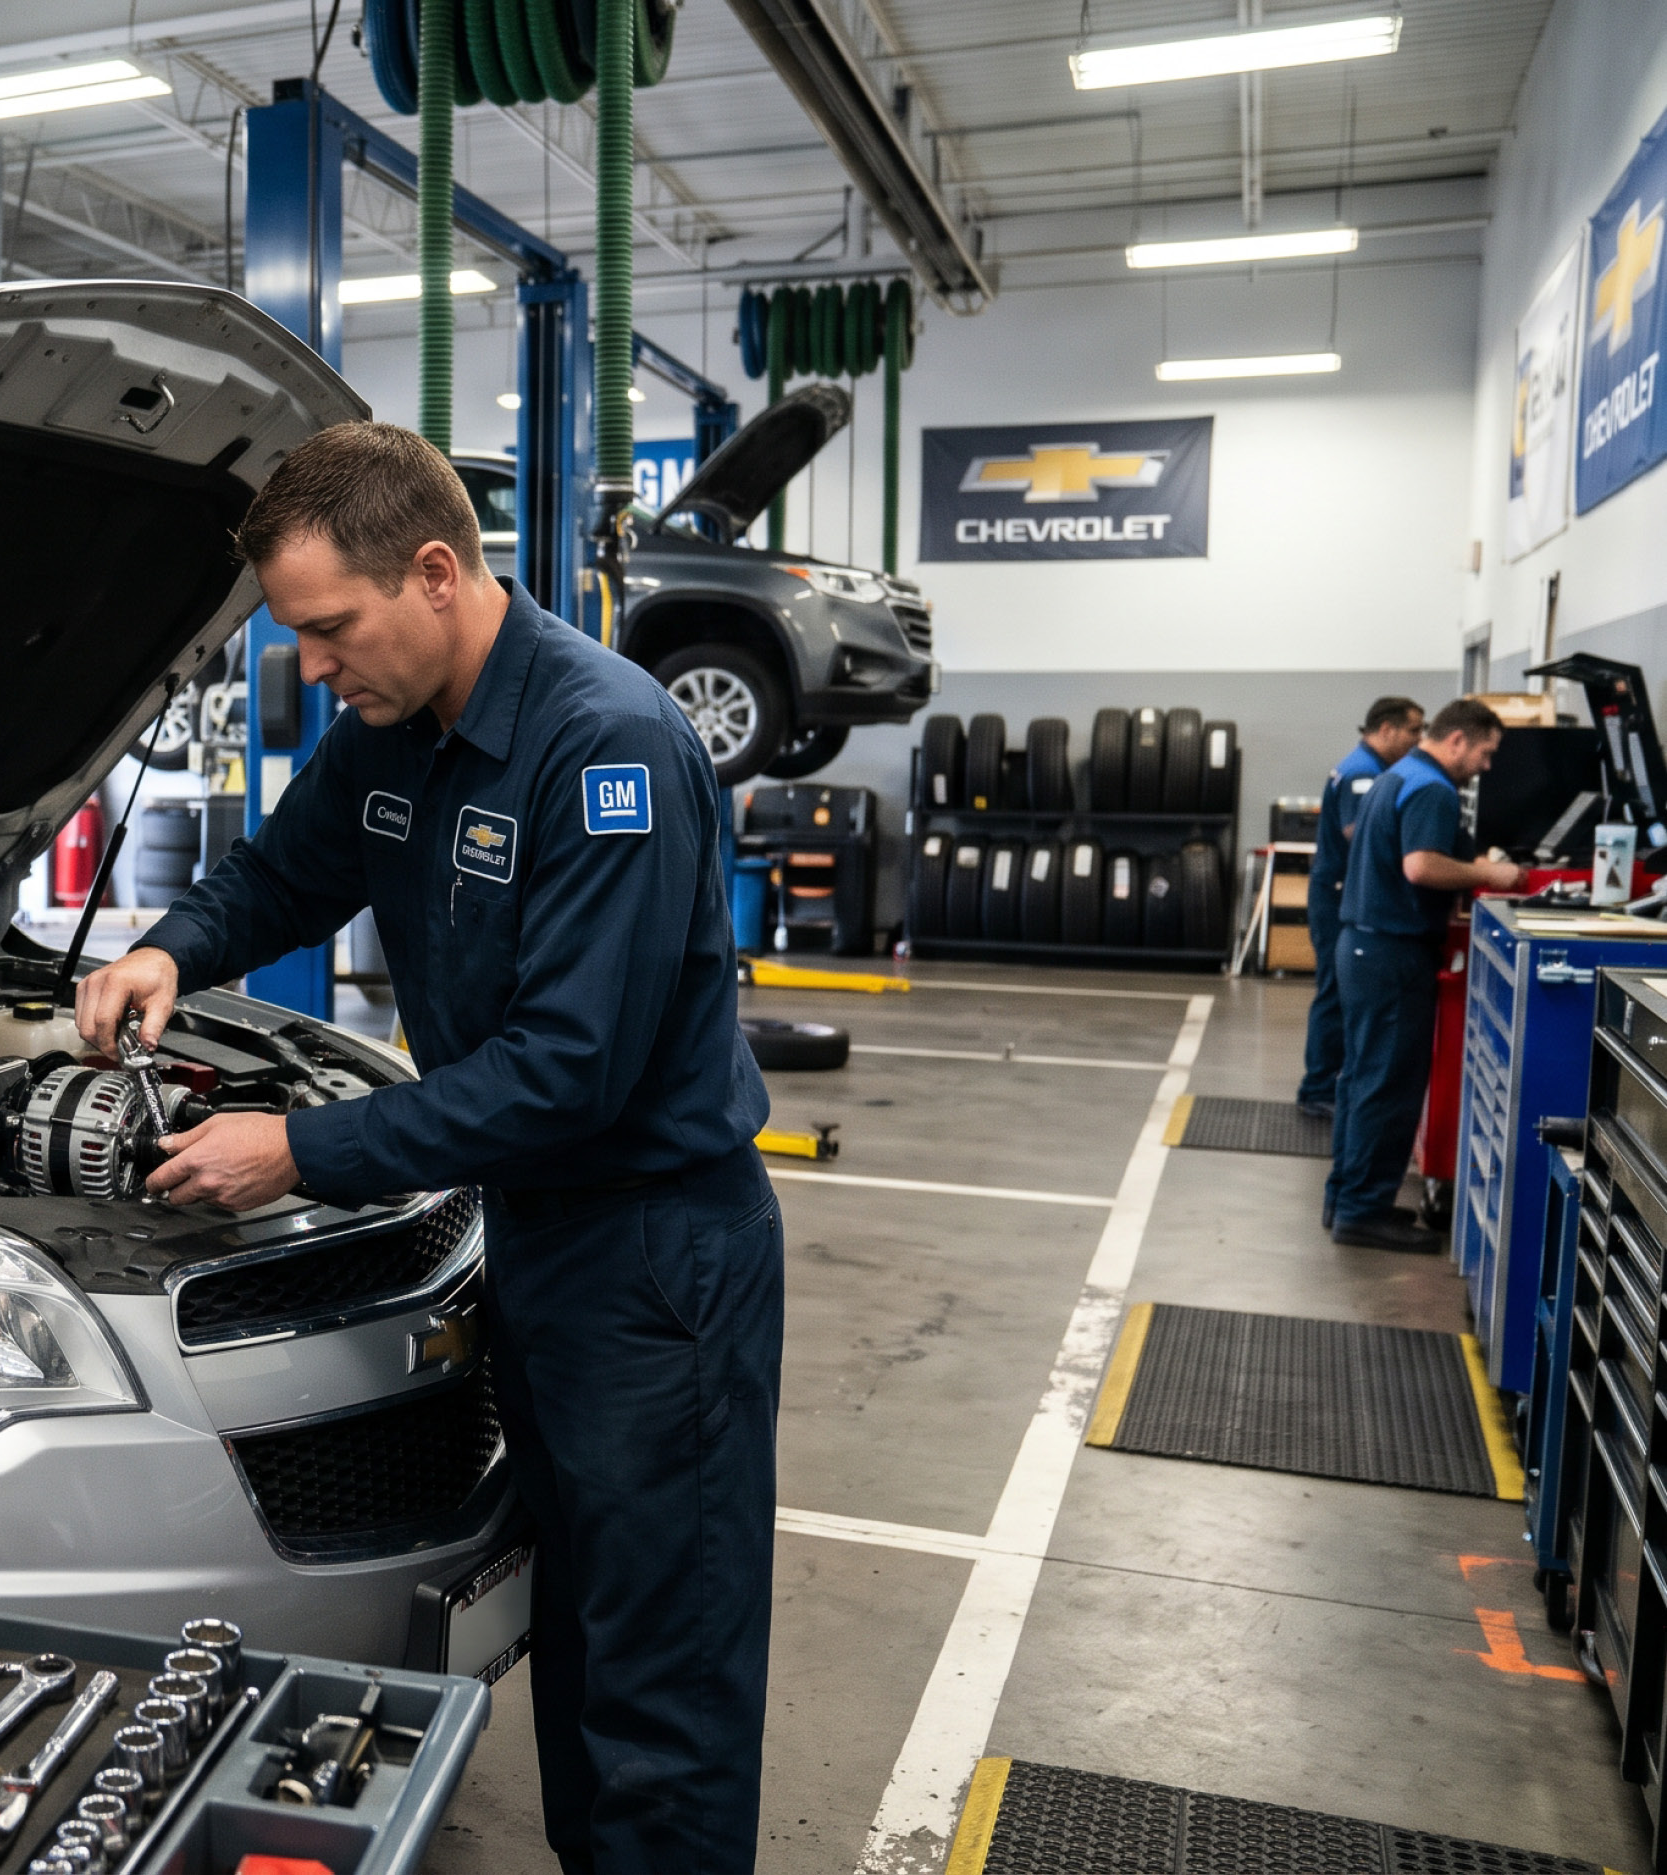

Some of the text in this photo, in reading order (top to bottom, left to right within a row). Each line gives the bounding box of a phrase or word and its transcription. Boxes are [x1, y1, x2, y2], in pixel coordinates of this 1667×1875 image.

[634, 457, 695, 510] GM
[956, 514, 1172, 543] CHEVROLET
[599, 780, 637, 809] GM
